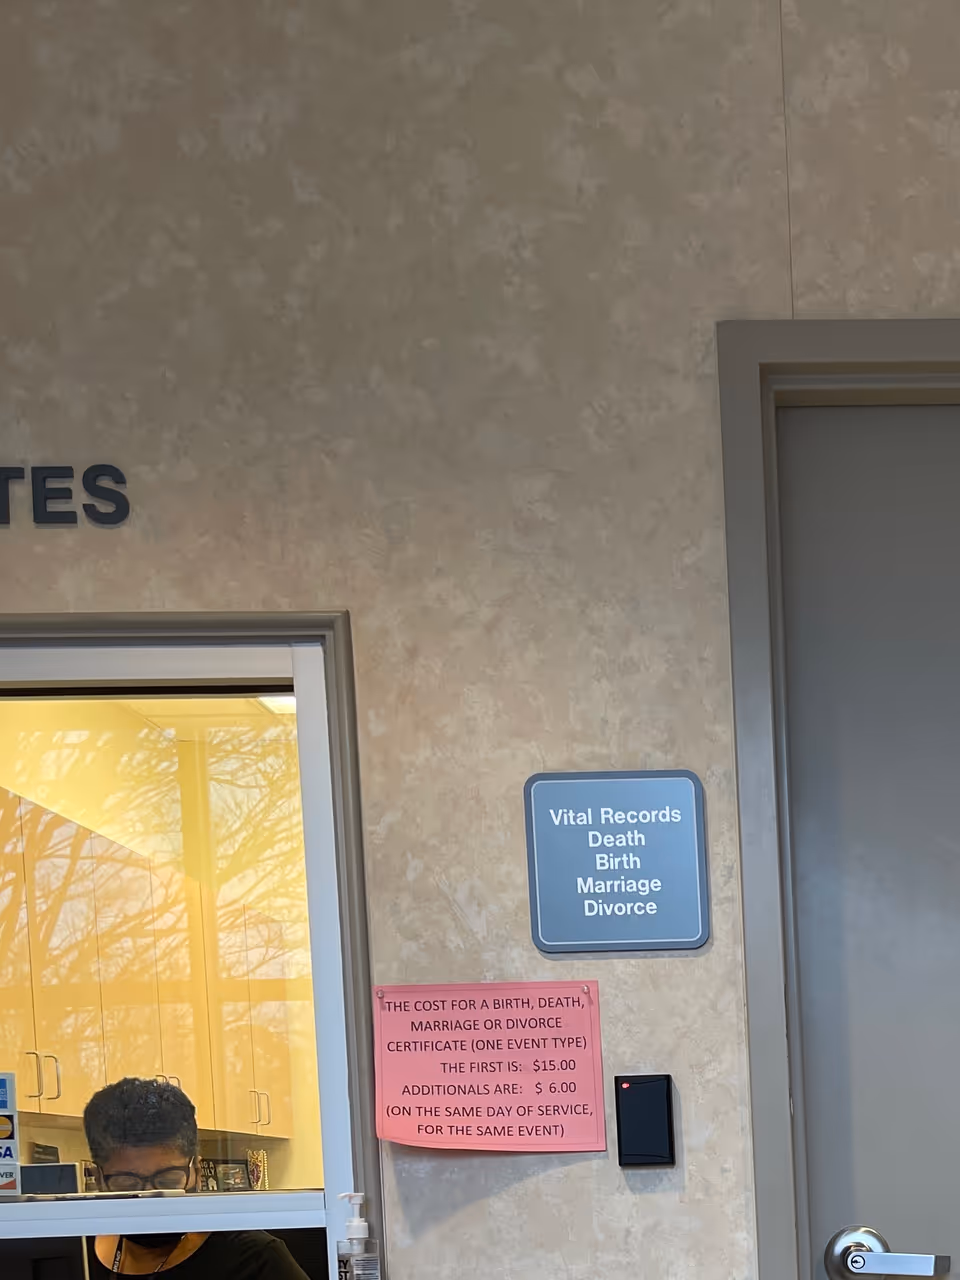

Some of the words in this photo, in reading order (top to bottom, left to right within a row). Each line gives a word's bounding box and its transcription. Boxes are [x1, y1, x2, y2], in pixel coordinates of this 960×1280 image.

[550, 808, 592, 826] Vital
[600, 806, 682, 824] Records
[588, 830, 646, 847] Death
[595, 853, 641, 870] Birth
[576, 876, 662, 895] Marriage
[584, 900, 658, 916] Divorce
[386, 1001, 410, 1012] THE
[414, 1000, 447, 1012] COST
[451, 999, 477, 1011] FOR
[480, 999, 489, 1010] A
[493, 998, 534, 1010] BIRTH,
[538, 997, 585, 1010] DEATH,
[410, 1020, 480, 1032] MARRIAGE
[483, 1019, 502, 1030] OR
[506, 1017, 562, 1030] DIVORCE
[387, 1040, 467, 1052] CERTIFICATE
[471, 1038, 504, 1053] (ONE
[507, 1037, 548, 1050] EVENT
[551, 1036, 587, 1050] TYPE)
[440, 1062, 466, 1074] THE
[469, 1061, 503, 1073] FIRST
[507, 1061, 522, 1072] IS:
[533, 1059, 576, 1072] $15.00
[401, 1084, 490, 1096] ADDITIONALS
[494, 1083, 523, 1095] ARE:
[535, 1082, 542, 1095] $
[549, 1082, 577, 1094] 6.00
[386, 1105, 412, 1118] (ON
[416, 1106, 441, 1117] THE
[445, 1106, 482, 1117] SAME
[486, 1106, 512, 1117] DAY
[516, 1105, 533, 1116] OF
[538, 1104, 593, 1116] SERVICE,
[417, 1124, 443, 1135] FOR
[447, 1125, 472, 1136] THE
[476, 1125, 514, 1137] SAME
[518, 1124, 565, 1138] EVENT)
